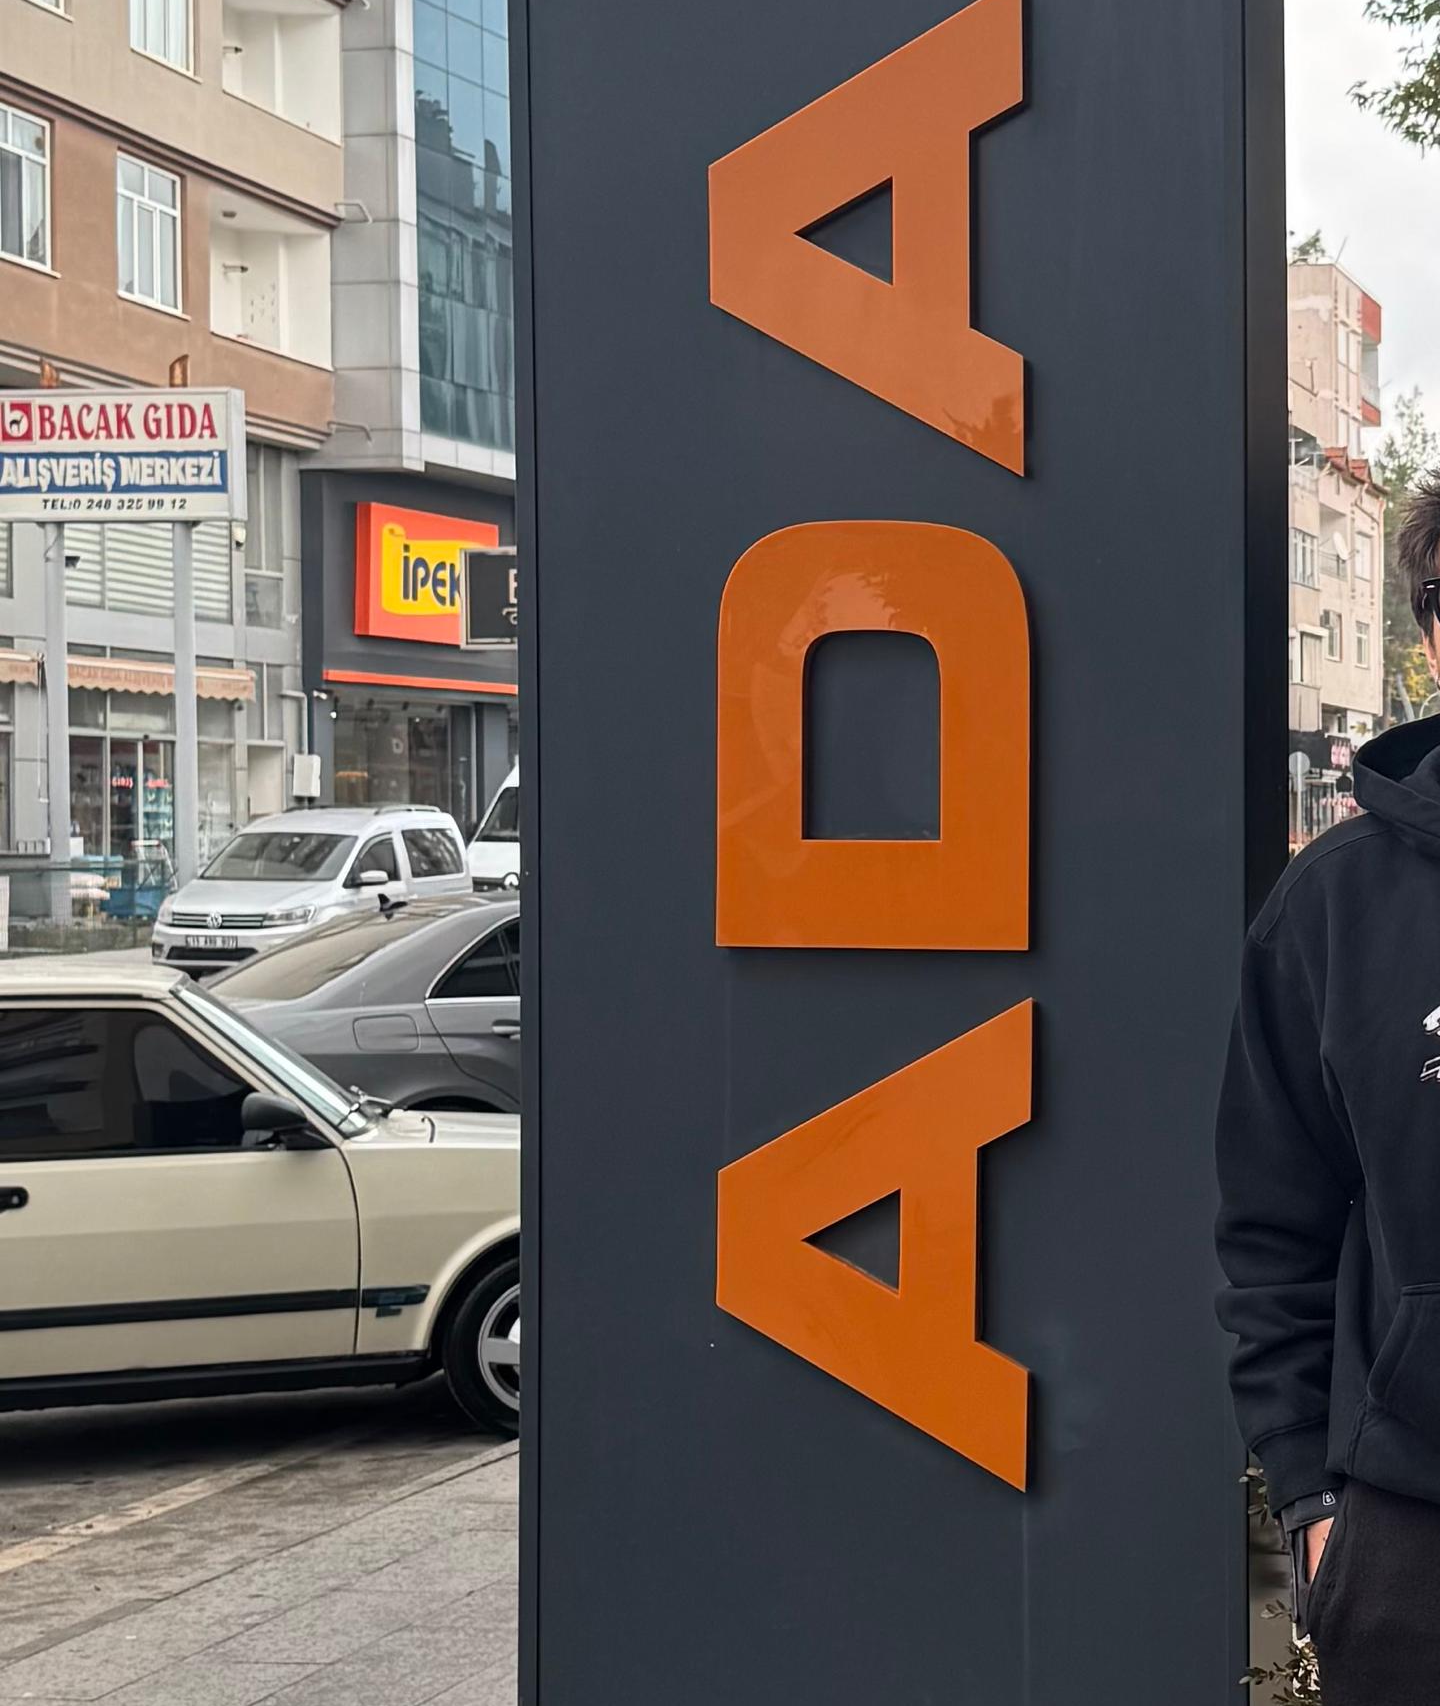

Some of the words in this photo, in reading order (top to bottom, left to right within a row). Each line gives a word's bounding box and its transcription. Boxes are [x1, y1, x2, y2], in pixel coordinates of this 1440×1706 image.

[38, 403, 135, 441] BACAK
[143, 402, 218, 440] GIDA
[0, 453, 116, 493] ALIŞVERİŞ
[119, 451, 223, 487] MERKEZİ
[171, 498, 188, 510] 12
